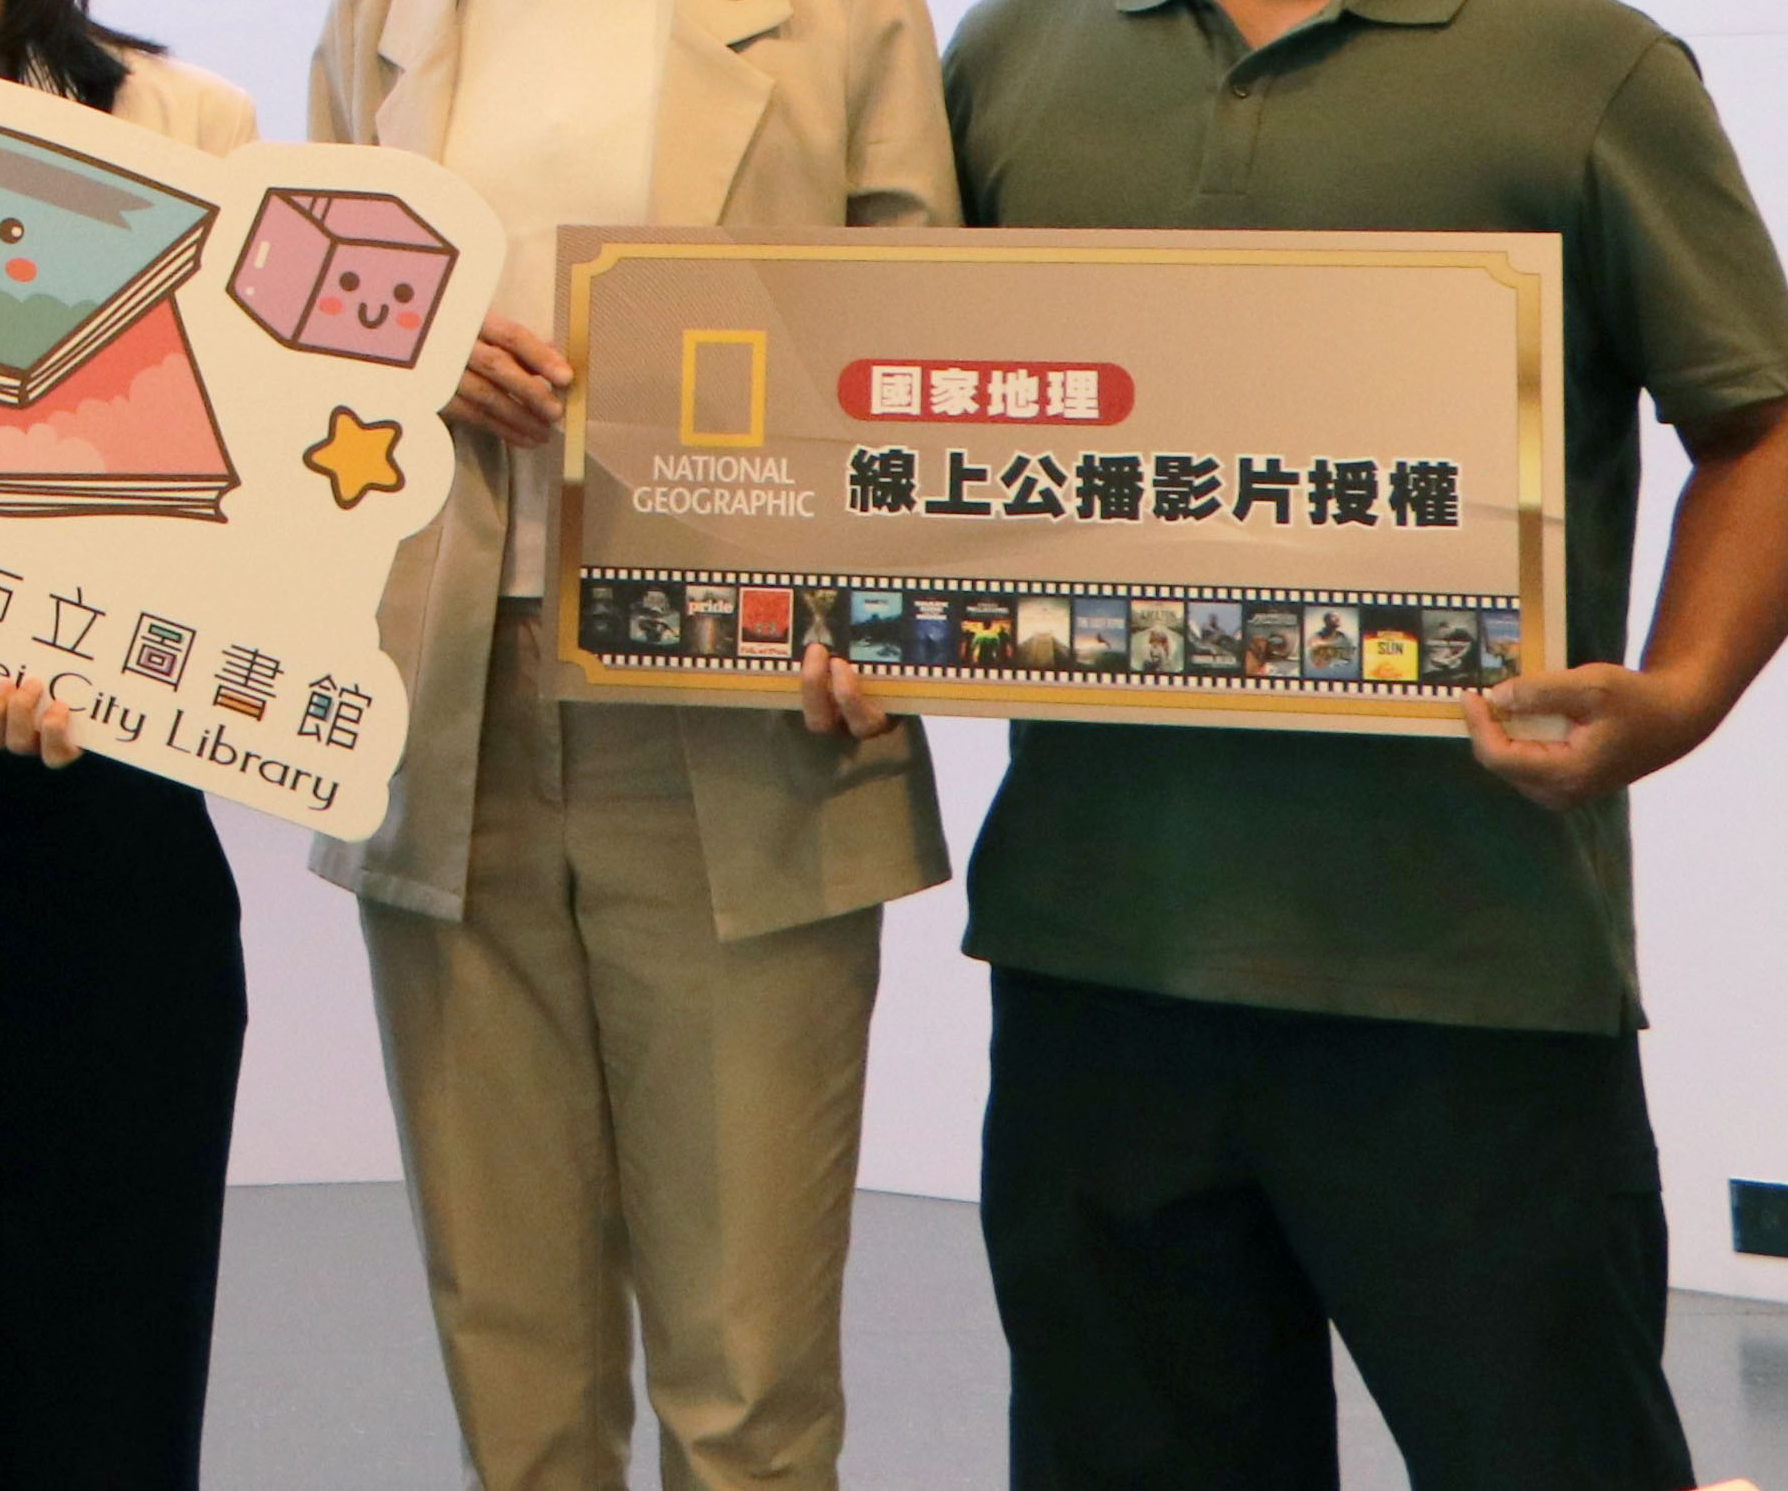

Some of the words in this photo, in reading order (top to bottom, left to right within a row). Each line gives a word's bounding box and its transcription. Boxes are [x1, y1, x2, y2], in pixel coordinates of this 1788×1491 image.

[870, 365, 1100, 419] 國家地理
[653, 455, 796, 485] NATIONAL
[633, 486, 816, 518] GEOGRAPHIC
[846, 446, 1461, 529] 線上公播影片授權
[687, 599, 735, 616] pride
[1377, 641, 1404, 656] SUN
[49, 672, 146, 742] City
[166, 708, 339, 811] Library
